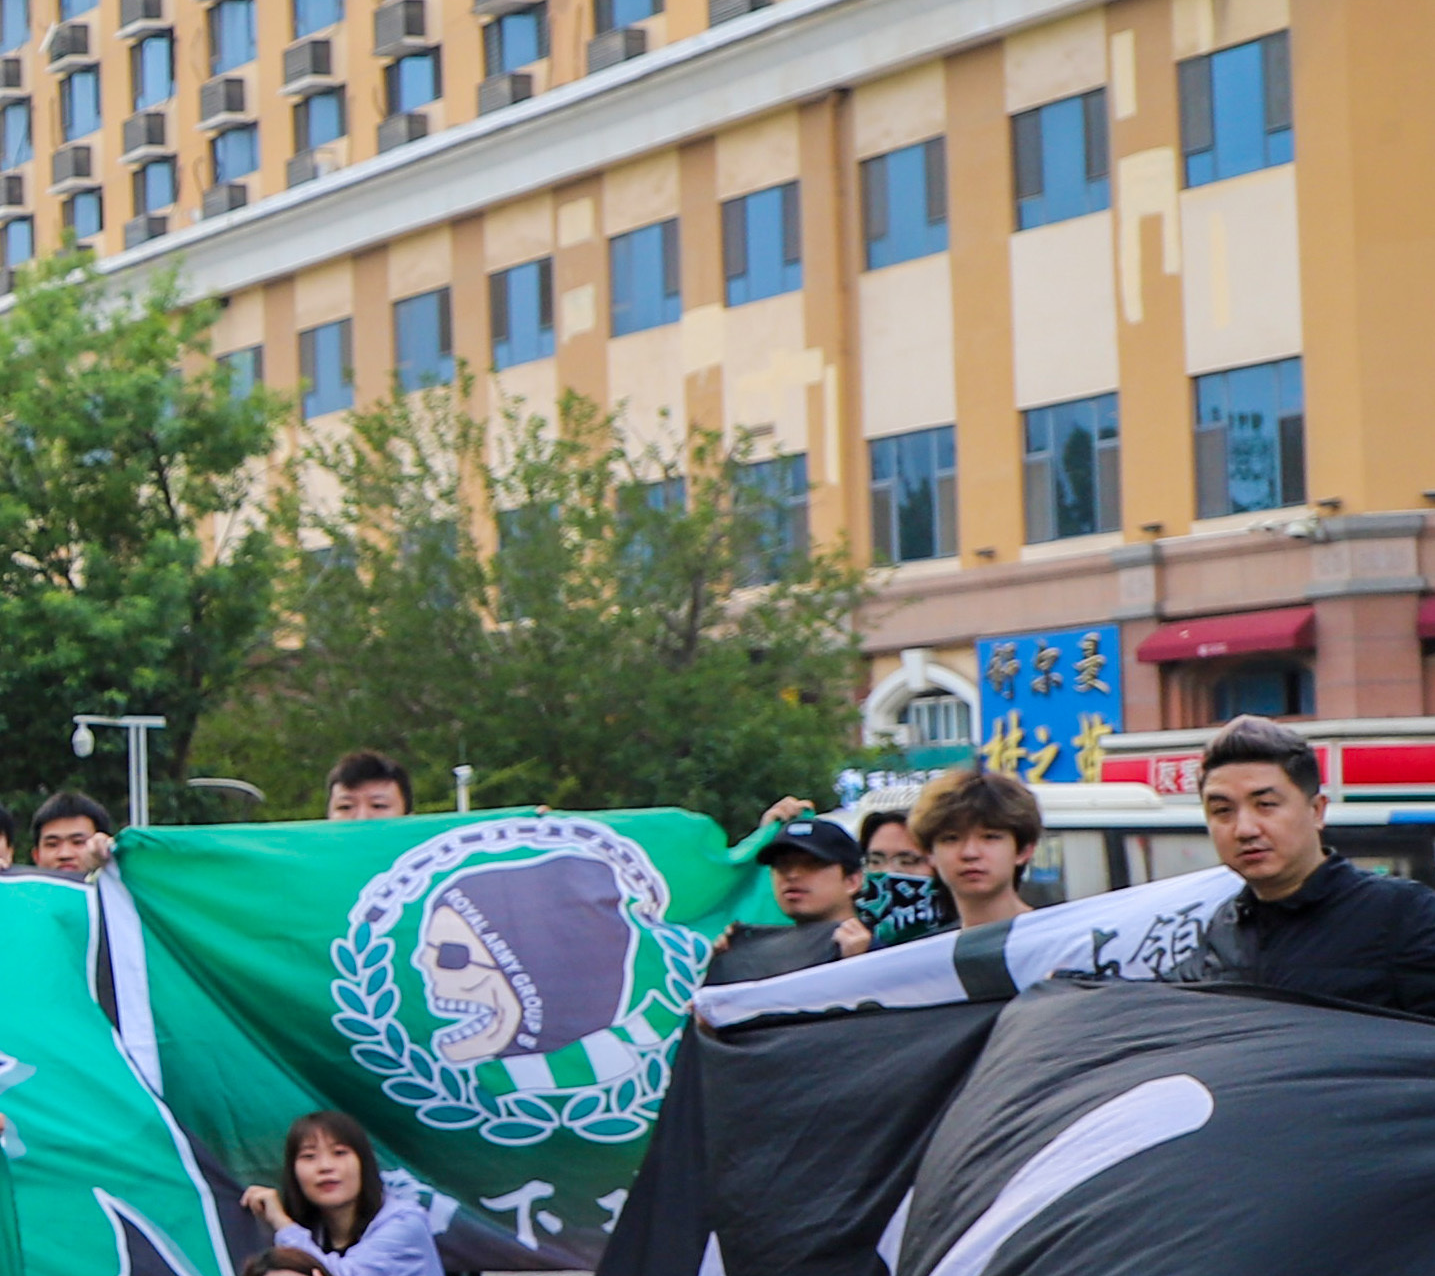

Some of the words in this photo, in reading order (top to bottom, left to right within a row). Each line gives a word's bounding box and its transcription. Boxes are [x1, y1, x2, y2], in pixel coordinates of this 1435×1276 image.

[443, 888, 489, 935] ROYAL
[481, 931, 524, 974] ARMY
[511, 973, 543, 1034] GROUP
